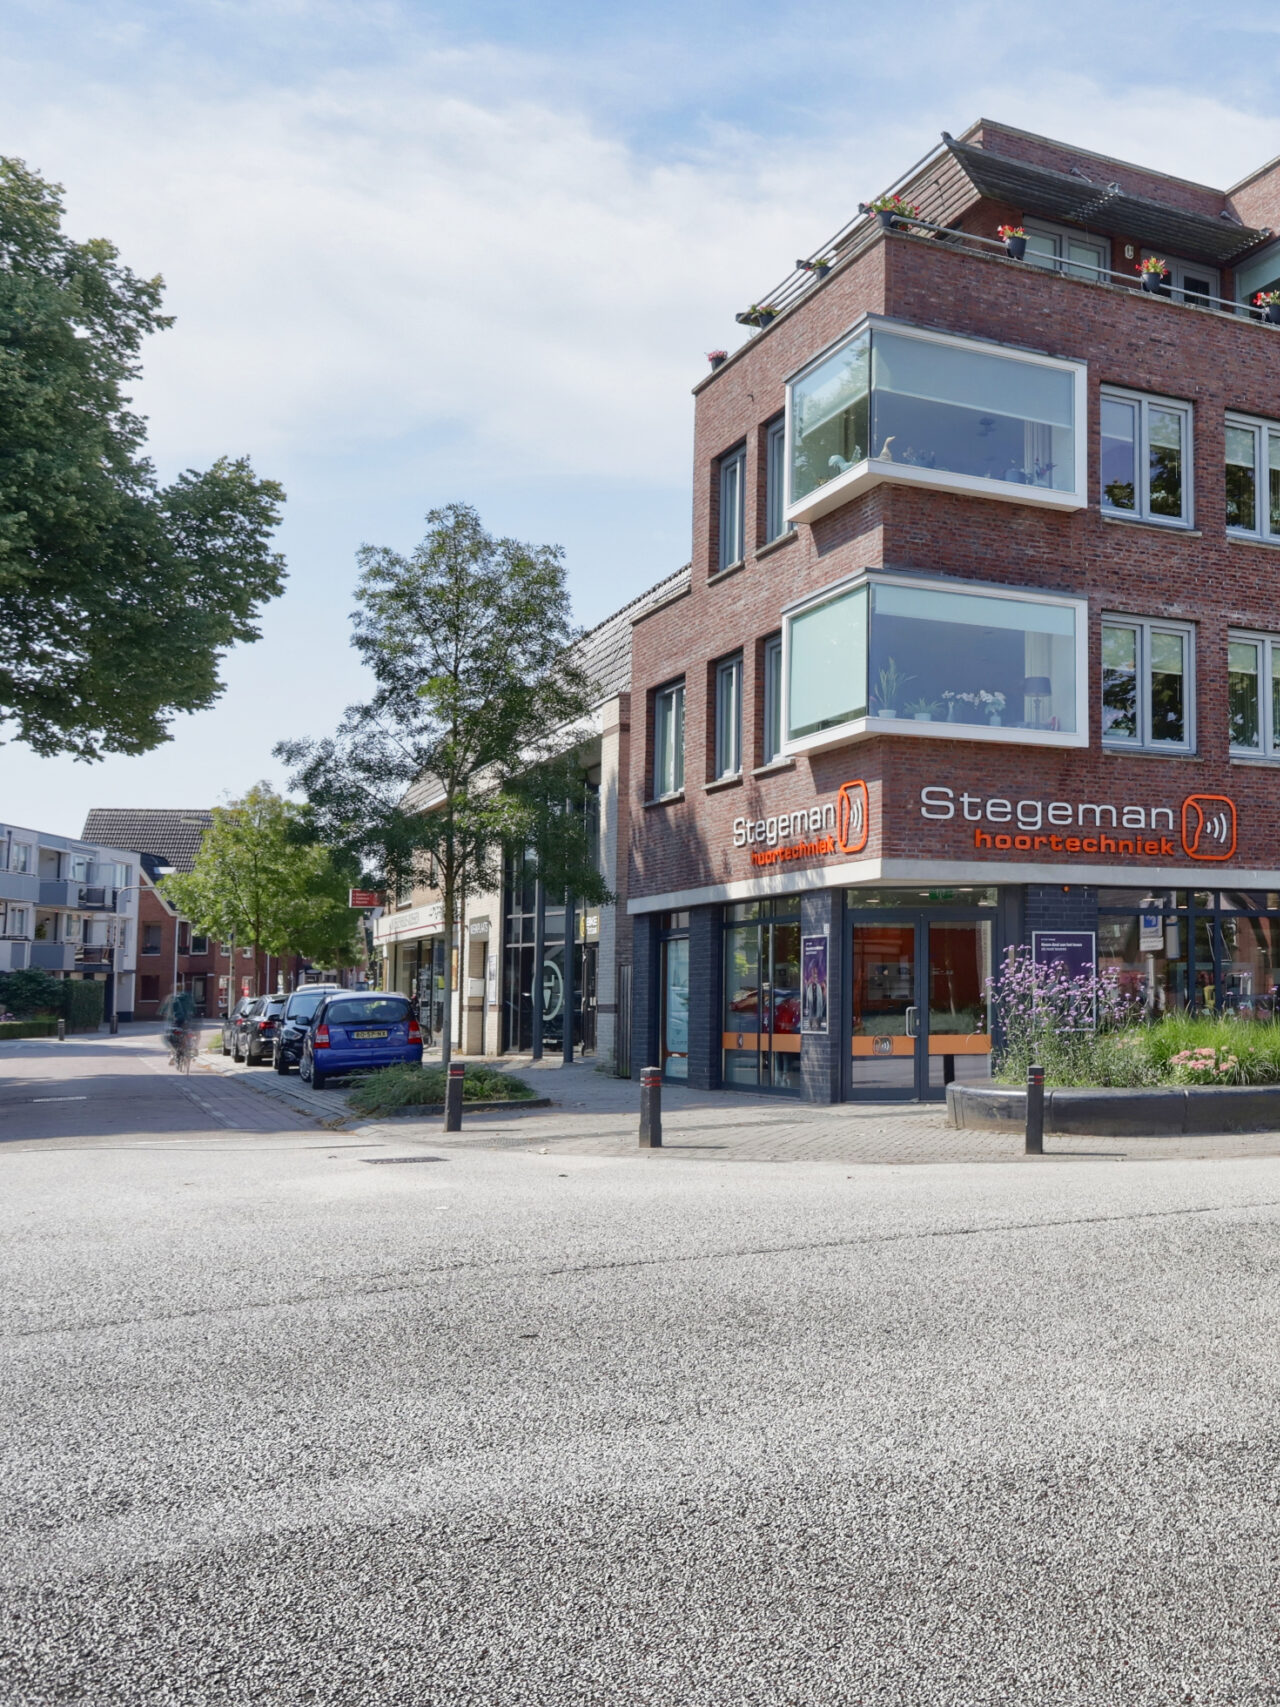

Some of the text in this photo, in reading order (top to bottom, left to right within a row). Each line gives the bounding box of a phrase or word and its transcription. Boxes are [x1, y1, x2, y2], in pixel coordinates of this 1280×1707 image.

[733, 803, 835, 848] Stegeman
[920, 786, 1174, 831] Stegeman
[751, 834, 836, 867] hoortechniek
[974, 829, 1175, 856] hoortechniek
